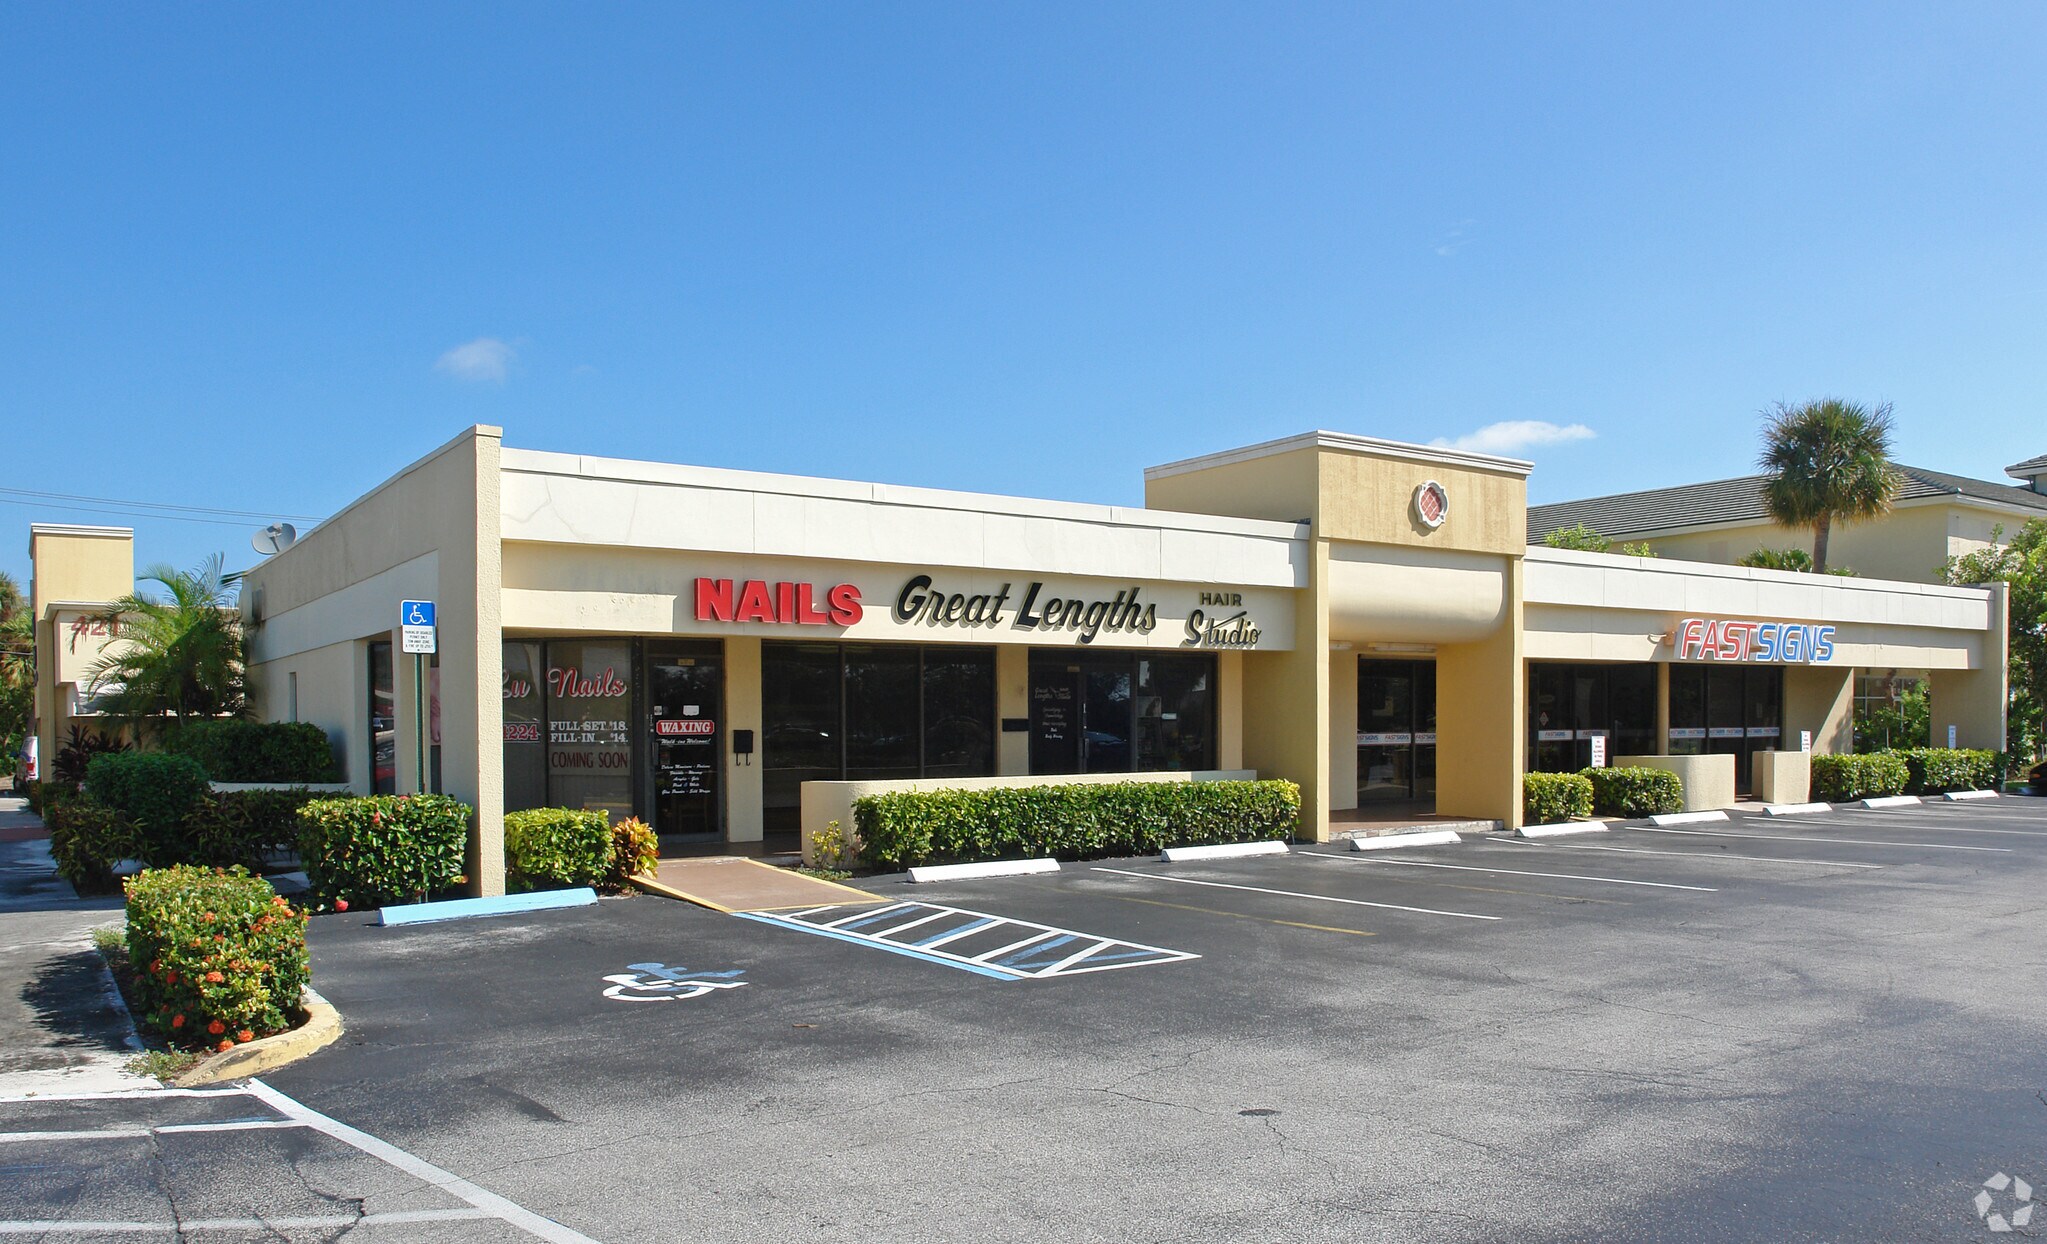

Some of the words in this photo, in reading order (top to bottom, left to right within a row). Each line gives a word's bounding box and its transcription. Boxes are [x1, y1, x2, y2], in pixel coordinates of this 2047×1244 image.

[694, 577, 863, 626] NAILS
[895, 575, 1011, 626] Great
[1016, 582, 1157, 644] Lengths
[1199, 592, 1242, 606] HAIR
[1184, 609, 1262, 645] Studio
[1677, 618, 1836, 662] FASTSIGNS
[546, 666, 628, 698] Nails
[550, 733, 595, 743] FILL-IN
[660, 722, 711, 733] WAXING
[551, 752, 593, 768] COMING
[598, 752, 628, 768] SOON
